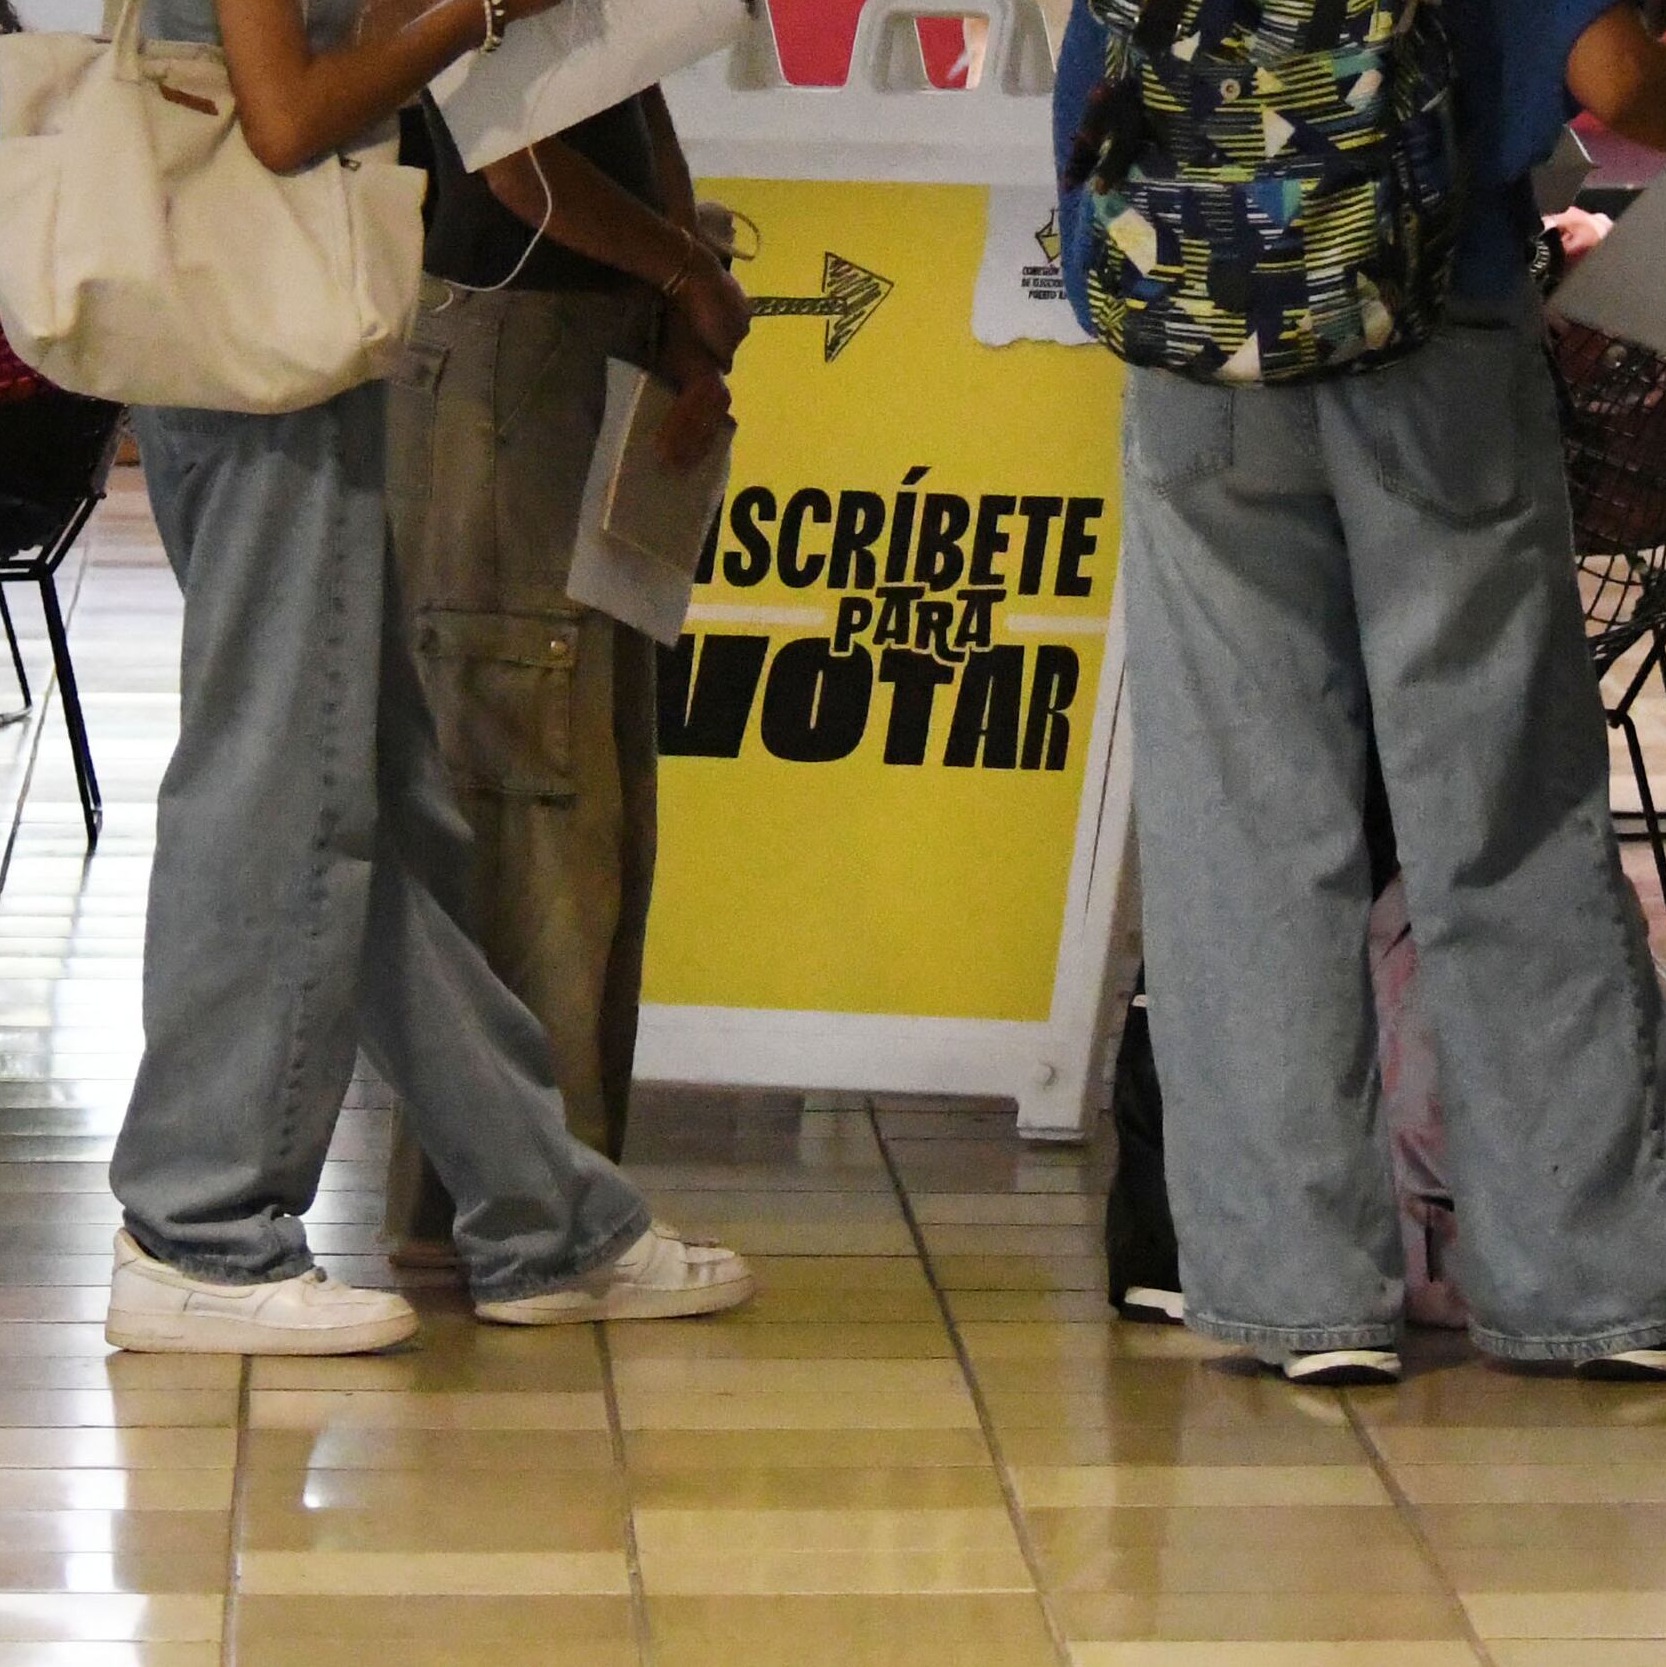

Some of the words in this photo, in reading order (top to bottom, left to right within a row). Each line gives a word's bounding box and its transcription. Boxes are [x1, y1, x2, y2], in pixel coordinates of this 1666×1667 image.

[694, 466, 1105, 598] SCRÍBETE
[833, 586, 1007, 662] PARA
[658, 633, 1080, 771] VOTAR
